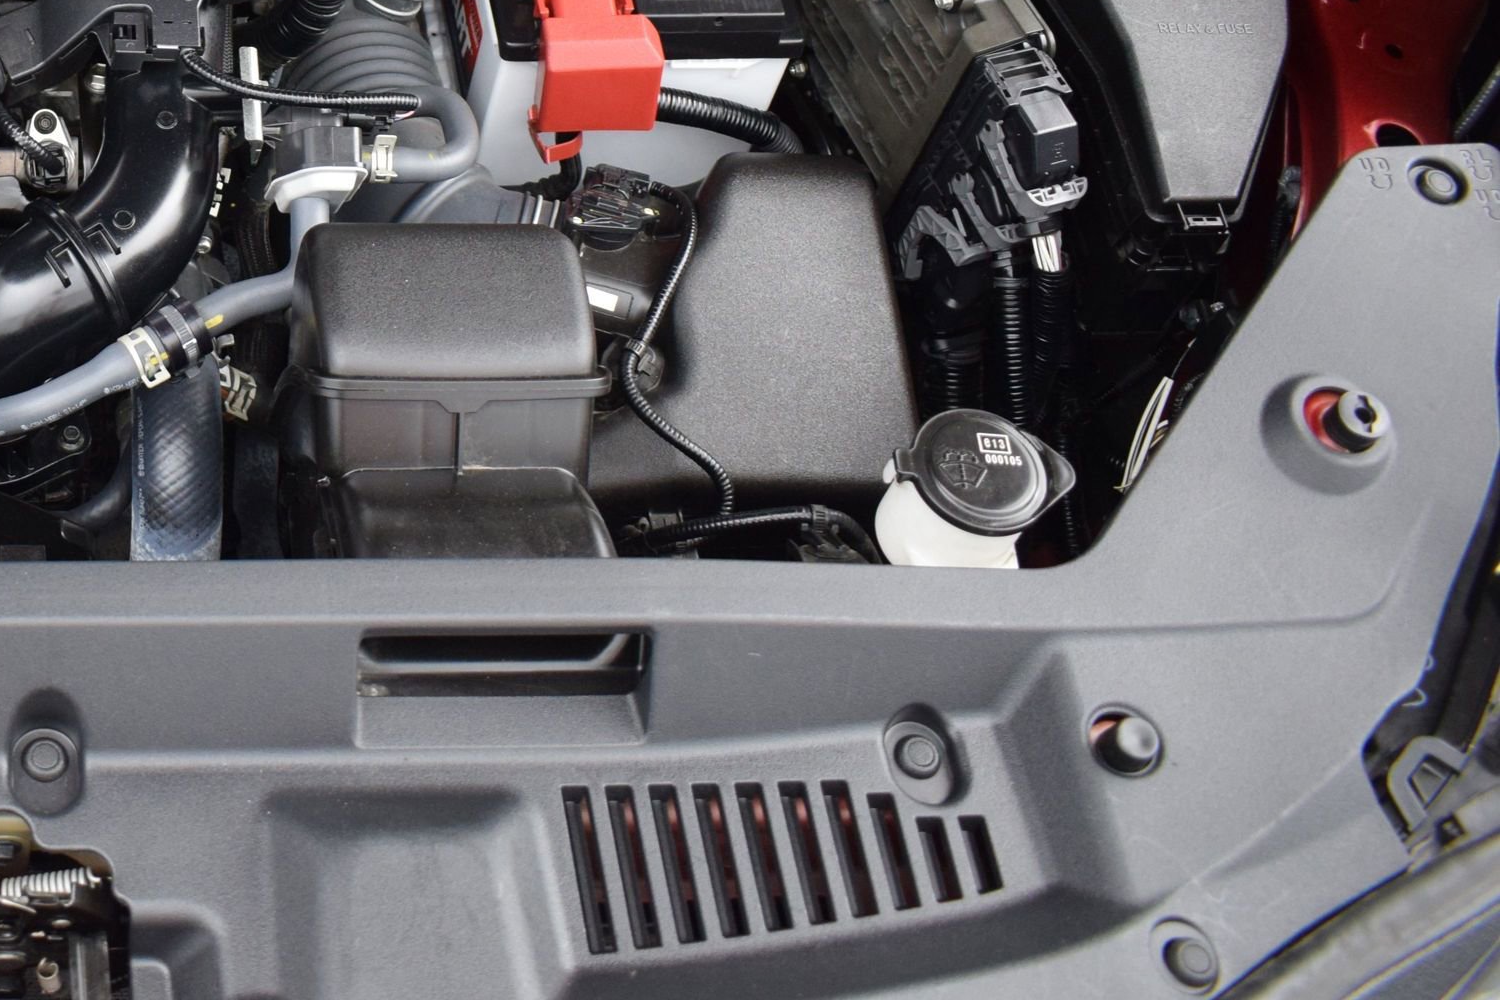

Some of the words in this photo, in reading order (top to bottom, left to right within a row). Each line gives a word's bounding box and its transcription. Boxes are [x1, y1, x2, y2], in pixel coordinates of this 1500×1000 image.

[1158, 22, 1201, 34] RELAY
[1217, 23, 1253, 34] FUSE
[985, 454, 1023, 467] 000105
